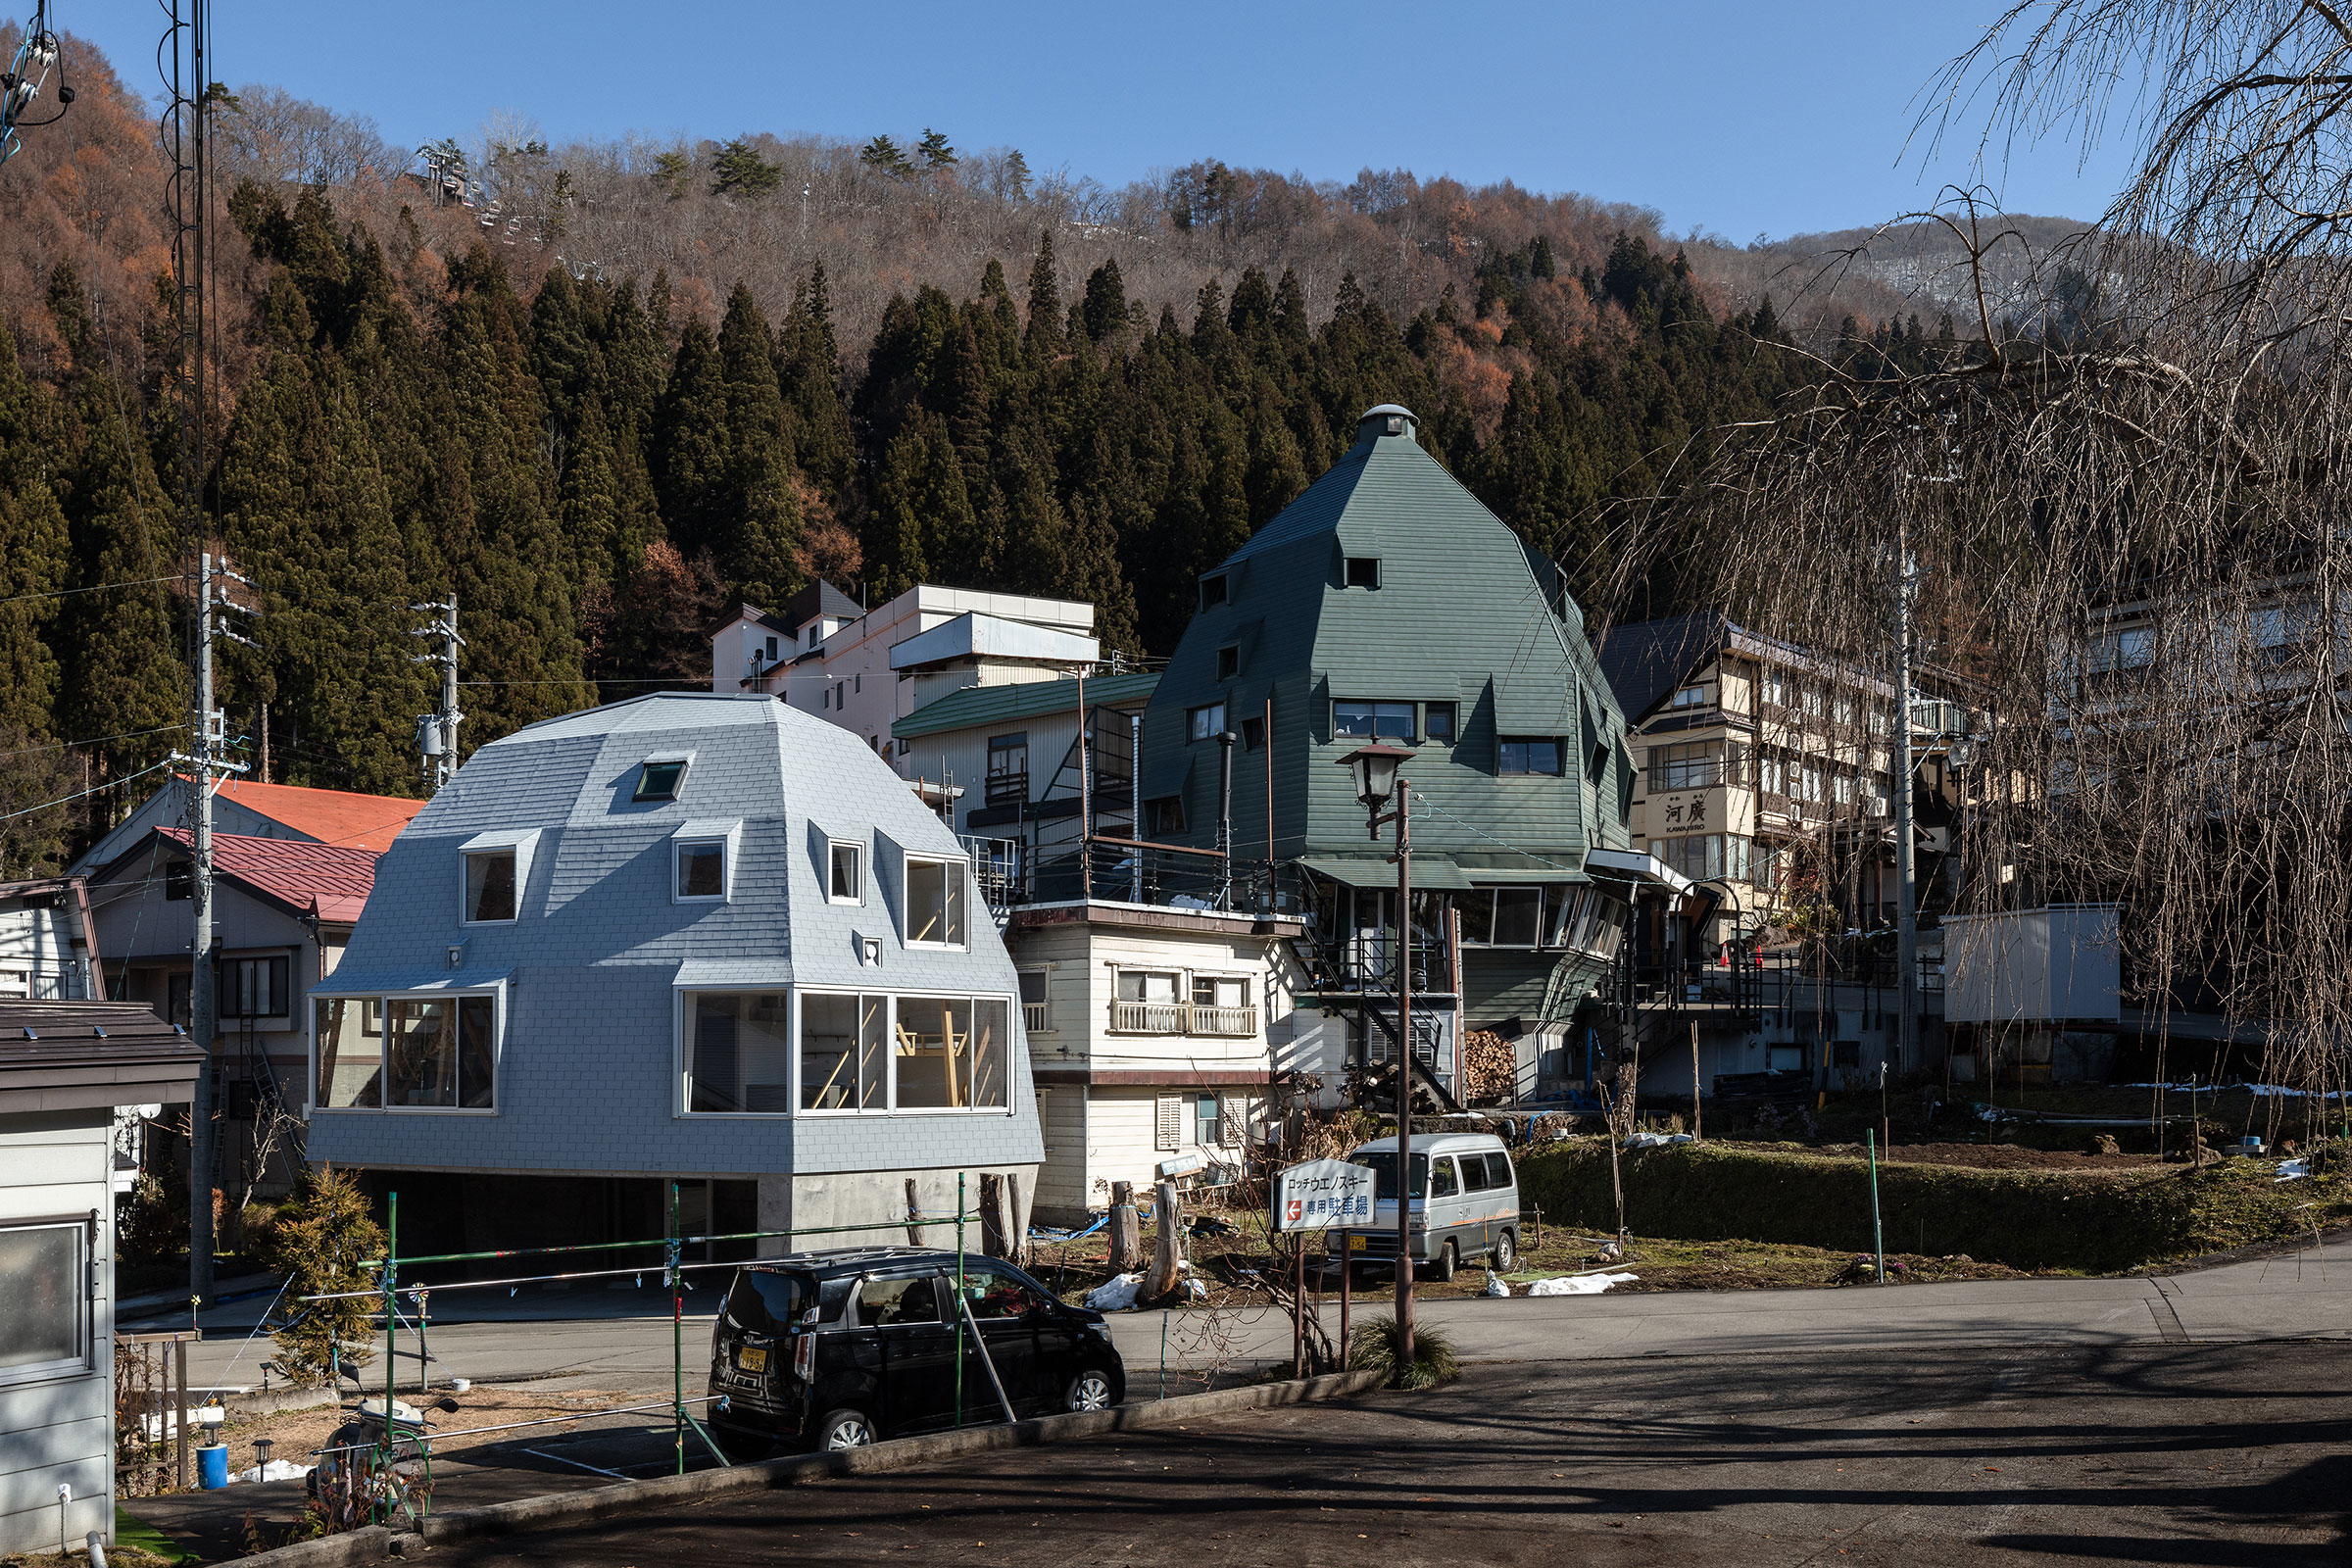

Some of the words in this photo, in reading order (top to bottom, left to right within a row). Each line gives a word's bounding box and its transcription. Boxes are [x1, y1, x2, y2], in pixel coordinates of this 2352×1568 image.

[1666, 824, 1705, 833] KAWAHIRO
[1288, 1175, 1368, 1192] ロッチウエノスキー
[1306, 1196, 1368, 1217] 専用駐車場
